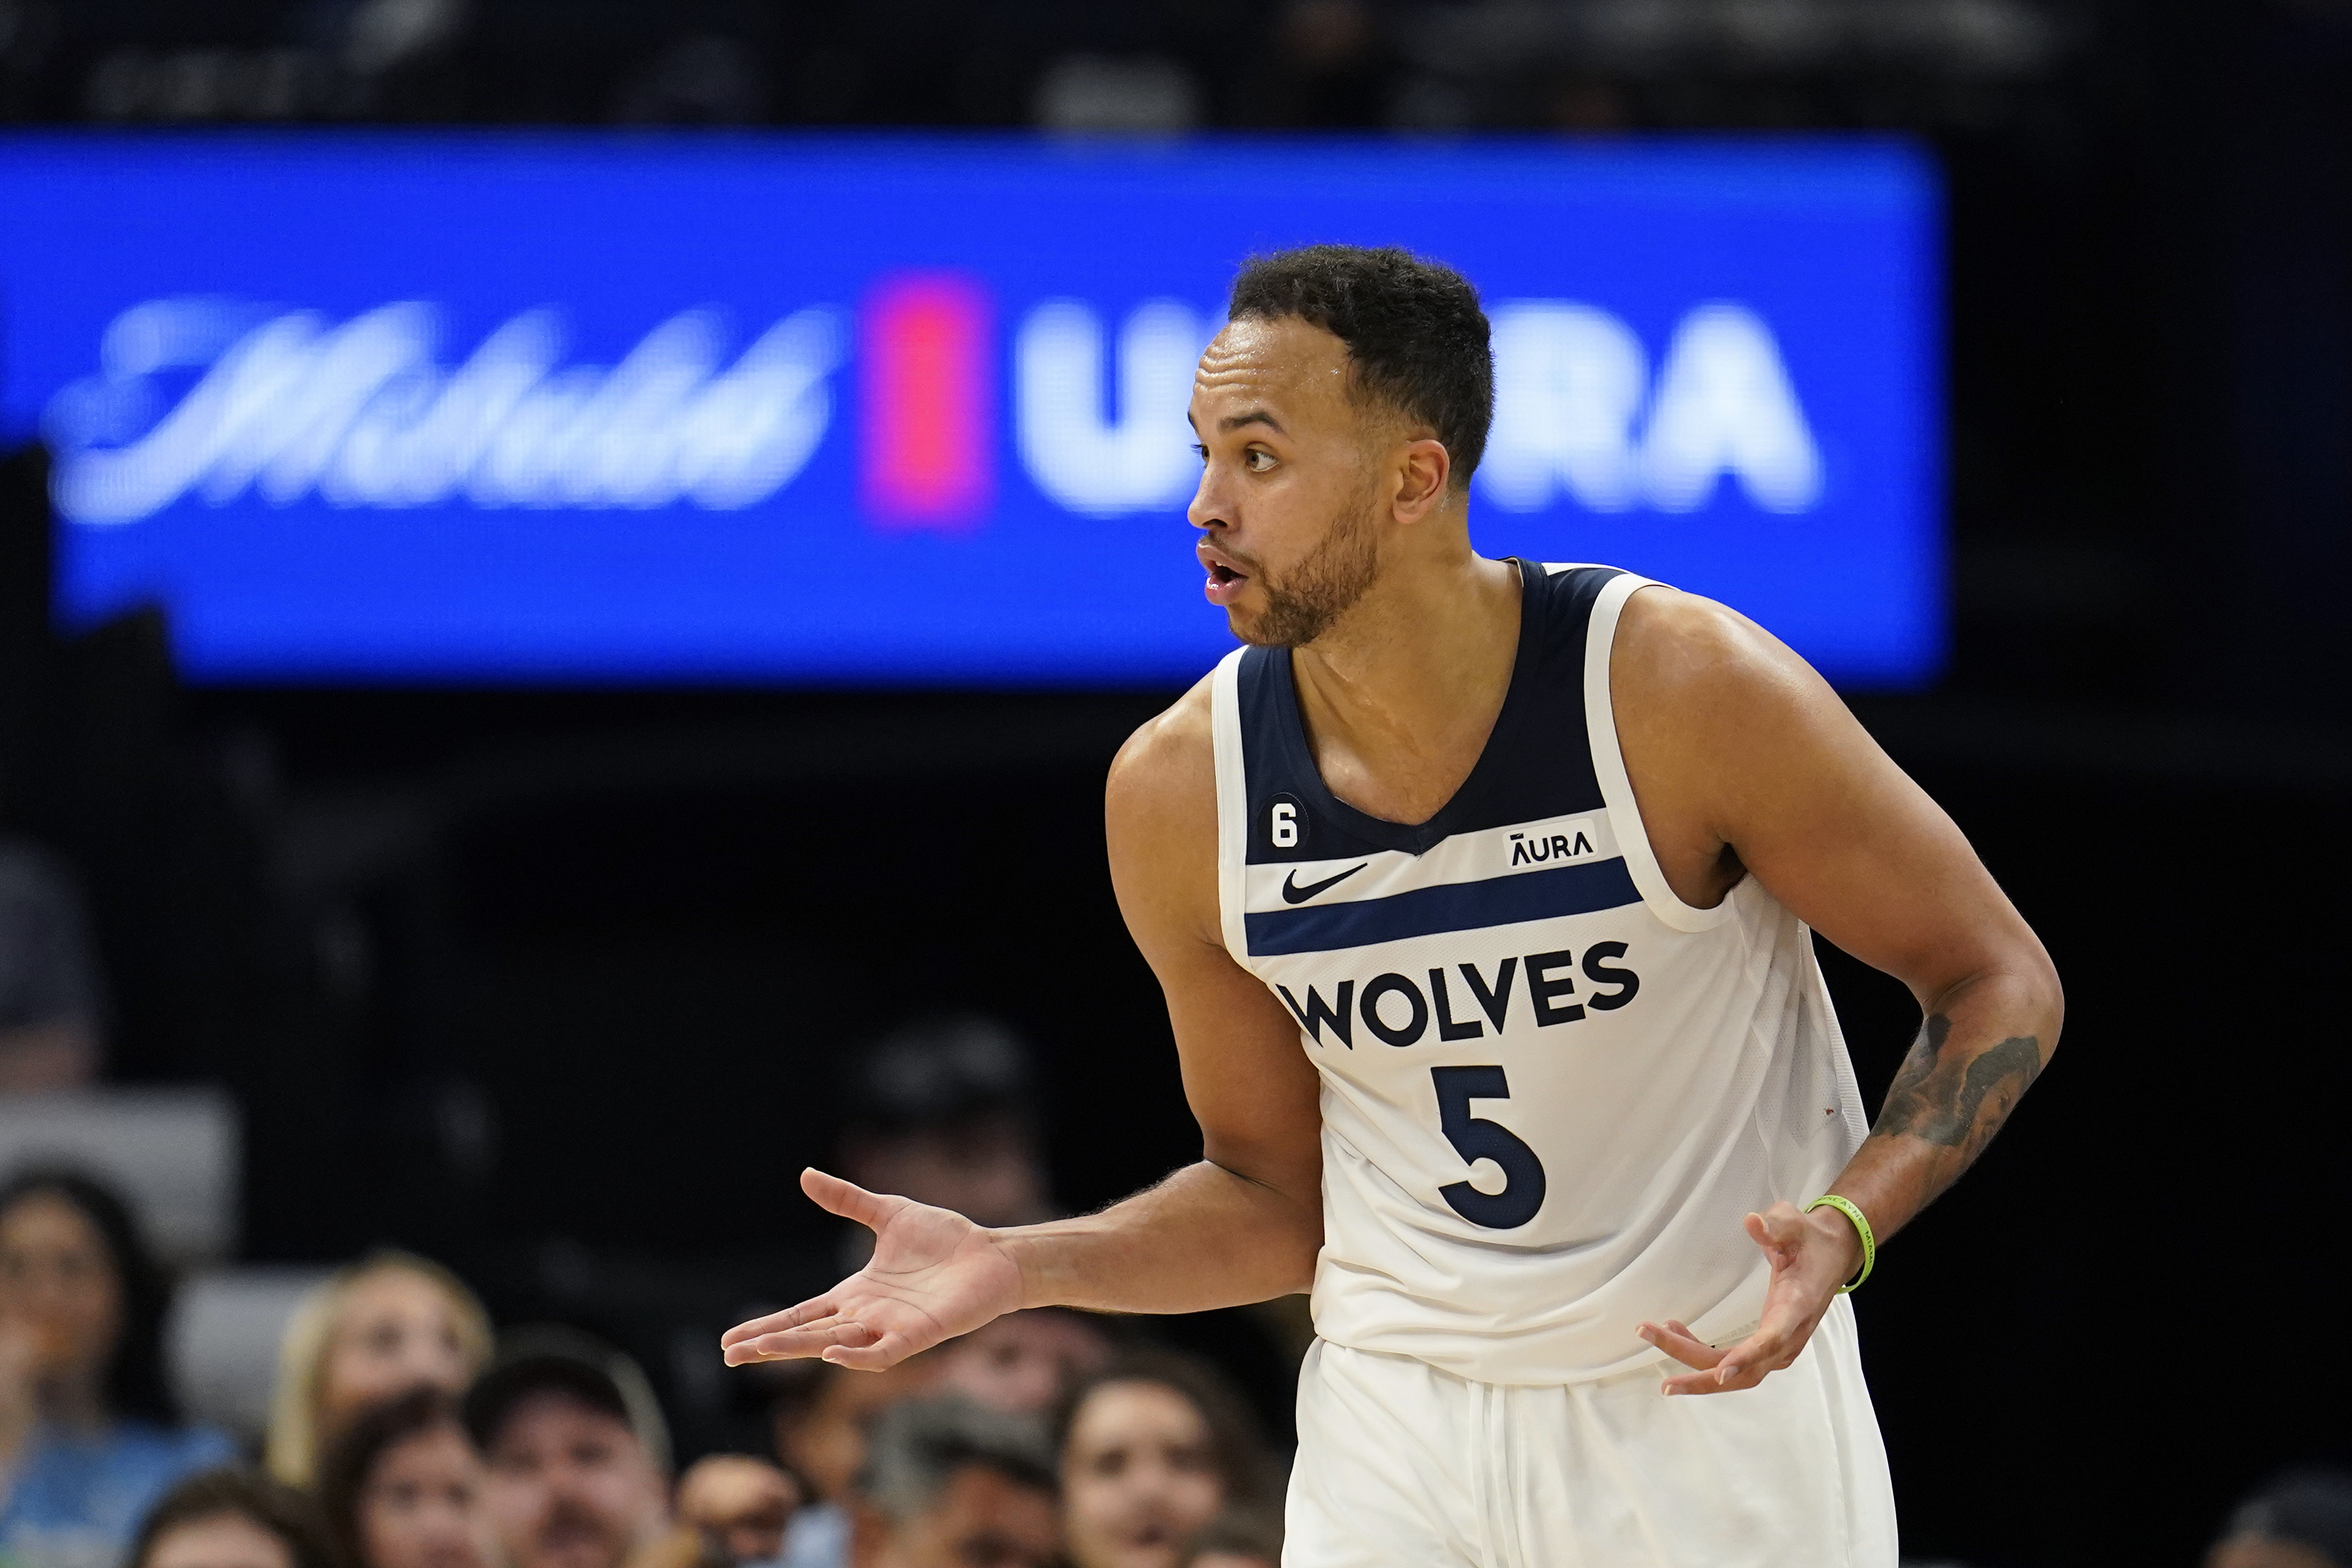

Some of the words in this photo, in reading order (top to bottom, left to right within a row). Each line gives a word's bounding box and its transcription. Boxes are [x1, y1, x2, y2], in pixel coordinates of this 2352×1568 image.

[1014, 297, 1824, 514] URA
[1272, 803, 1298, 848] 6
[1276, 940, 1640, 1051] WOLVES
[1430, 1065, 1546, 1230] 5
